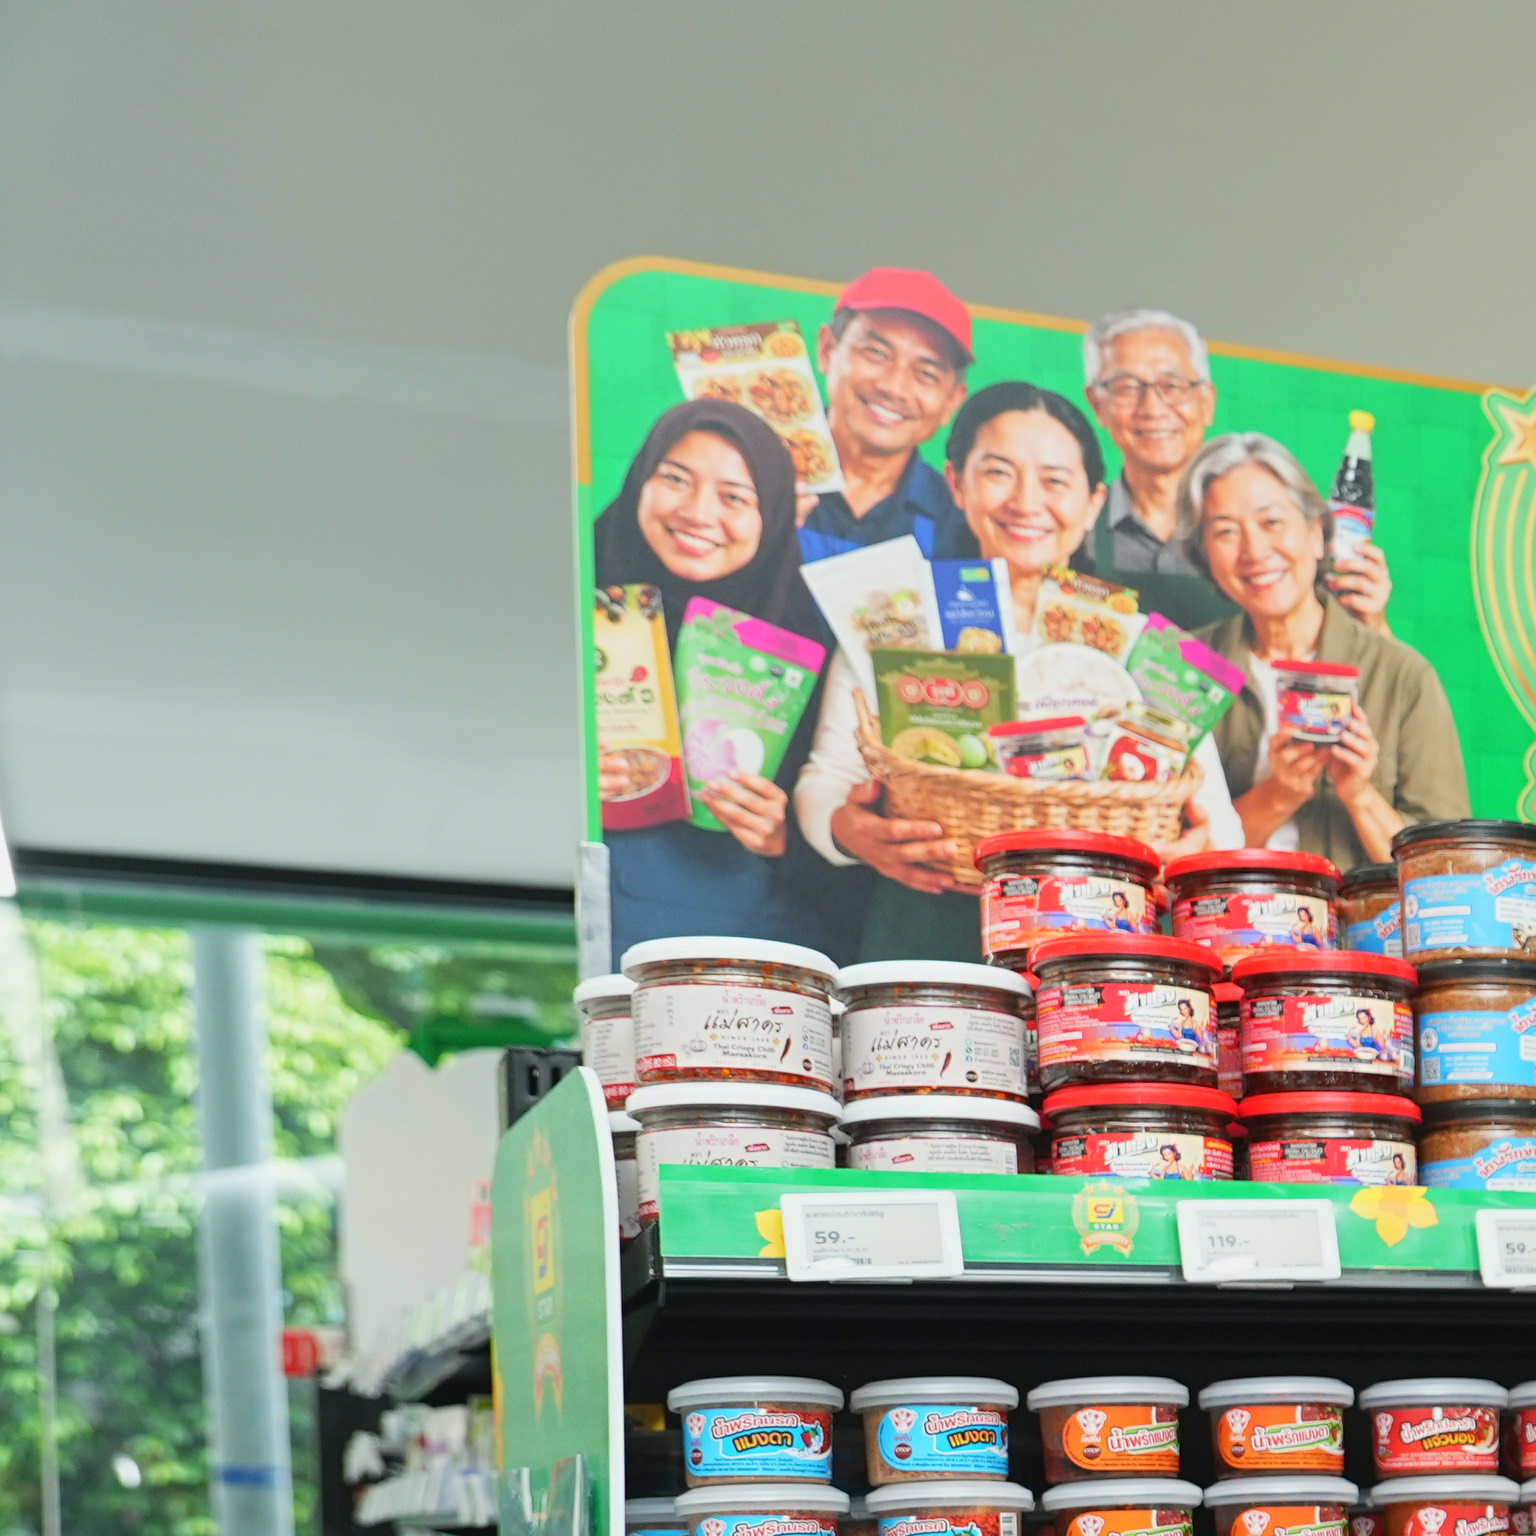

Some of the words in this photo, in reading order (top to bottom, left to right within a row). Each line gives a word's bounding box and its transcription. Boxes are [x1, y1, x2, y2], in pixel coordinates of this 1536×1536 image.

[703, 1009, 784, 1034] แม่สาคร
[870, 1029, 943, 1053] แม่สาคร
[813, 1230, 856, 1246] 59.-
[1093, 1222, 1121, 1231] STAR
[1207, 1234, 1250, 1249] 119.-
[711, 1412, 798, 1440] น้ำพริกนรก
[924, 1411, 1000, 1436] น้ำพริกนรก
[732, 1431, 794, 1454] แมงดา
[947, 1429, 997, 1449] แมงดา
